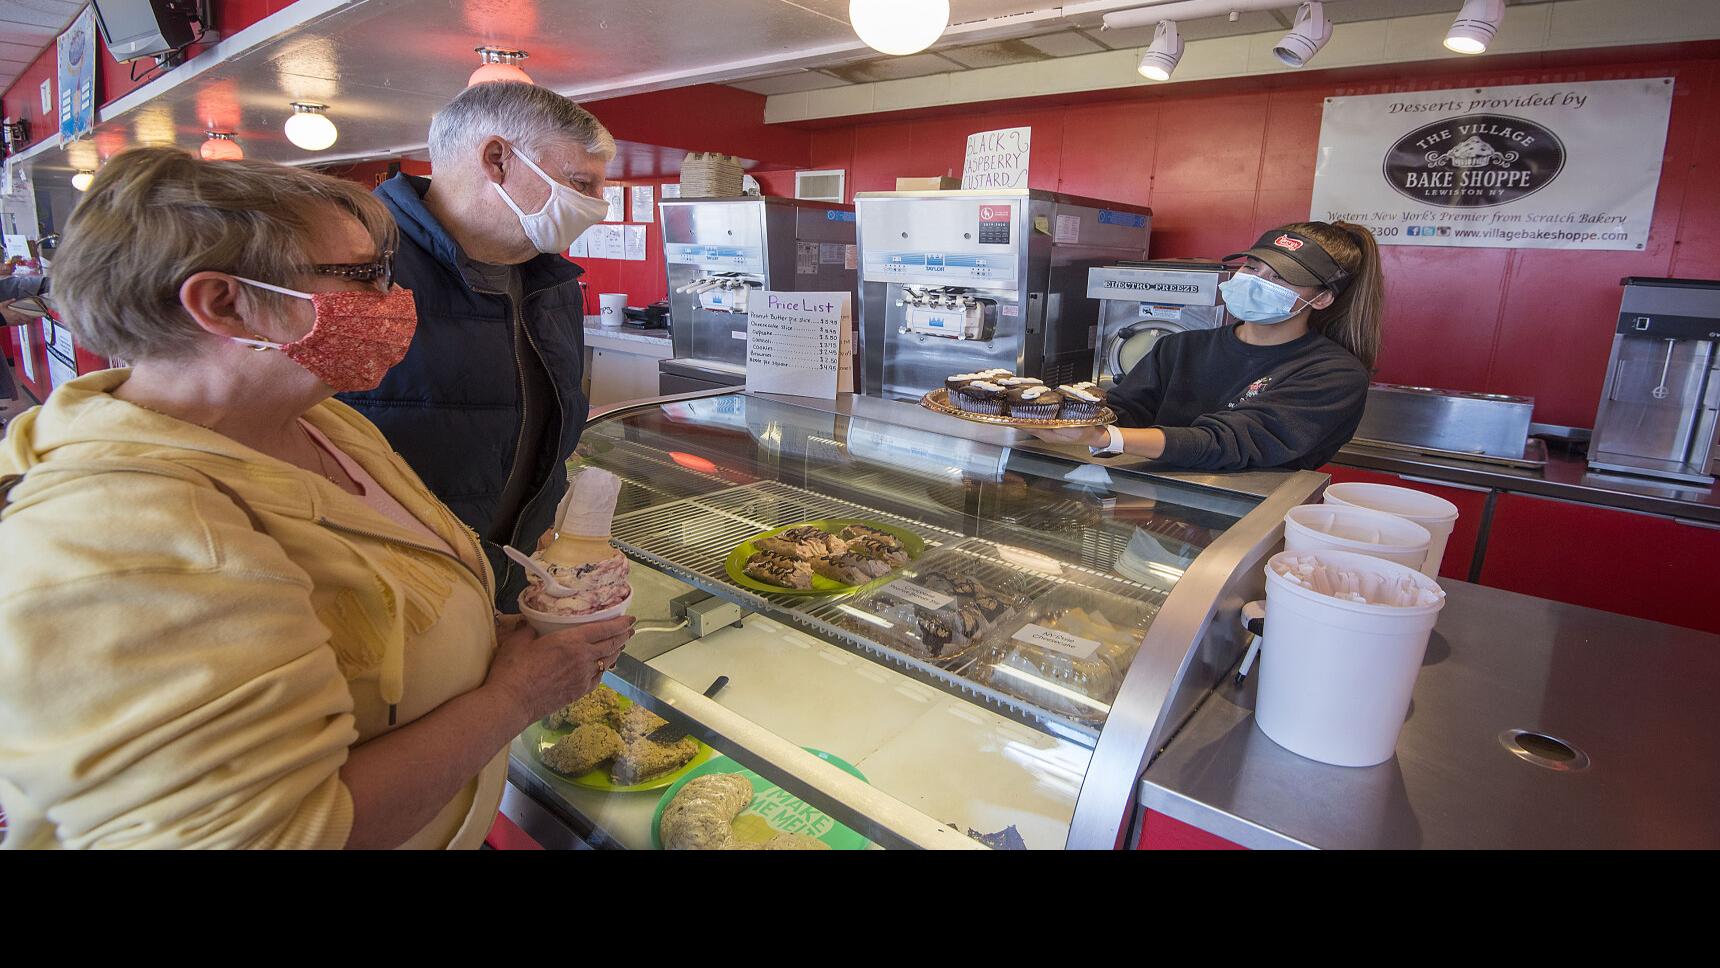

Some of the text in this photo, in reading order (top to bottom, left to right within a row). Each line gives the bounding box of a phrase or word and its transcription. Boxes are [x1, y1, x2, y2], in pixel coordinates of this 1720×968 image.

[1388, 91, 1588, 114] Desserts provided by
[1416, 123, 1535, 150] THE VILLAGE
[1405, 170, 1532, 188] BAKE SHOPPE
[1327, 210, 1628, 226] Western New York's Premier from Scratch Bakery
[1454, 227, 1628, 243] www.villagebakeshoppe.com
[768, 294, 834, 313] Price List
